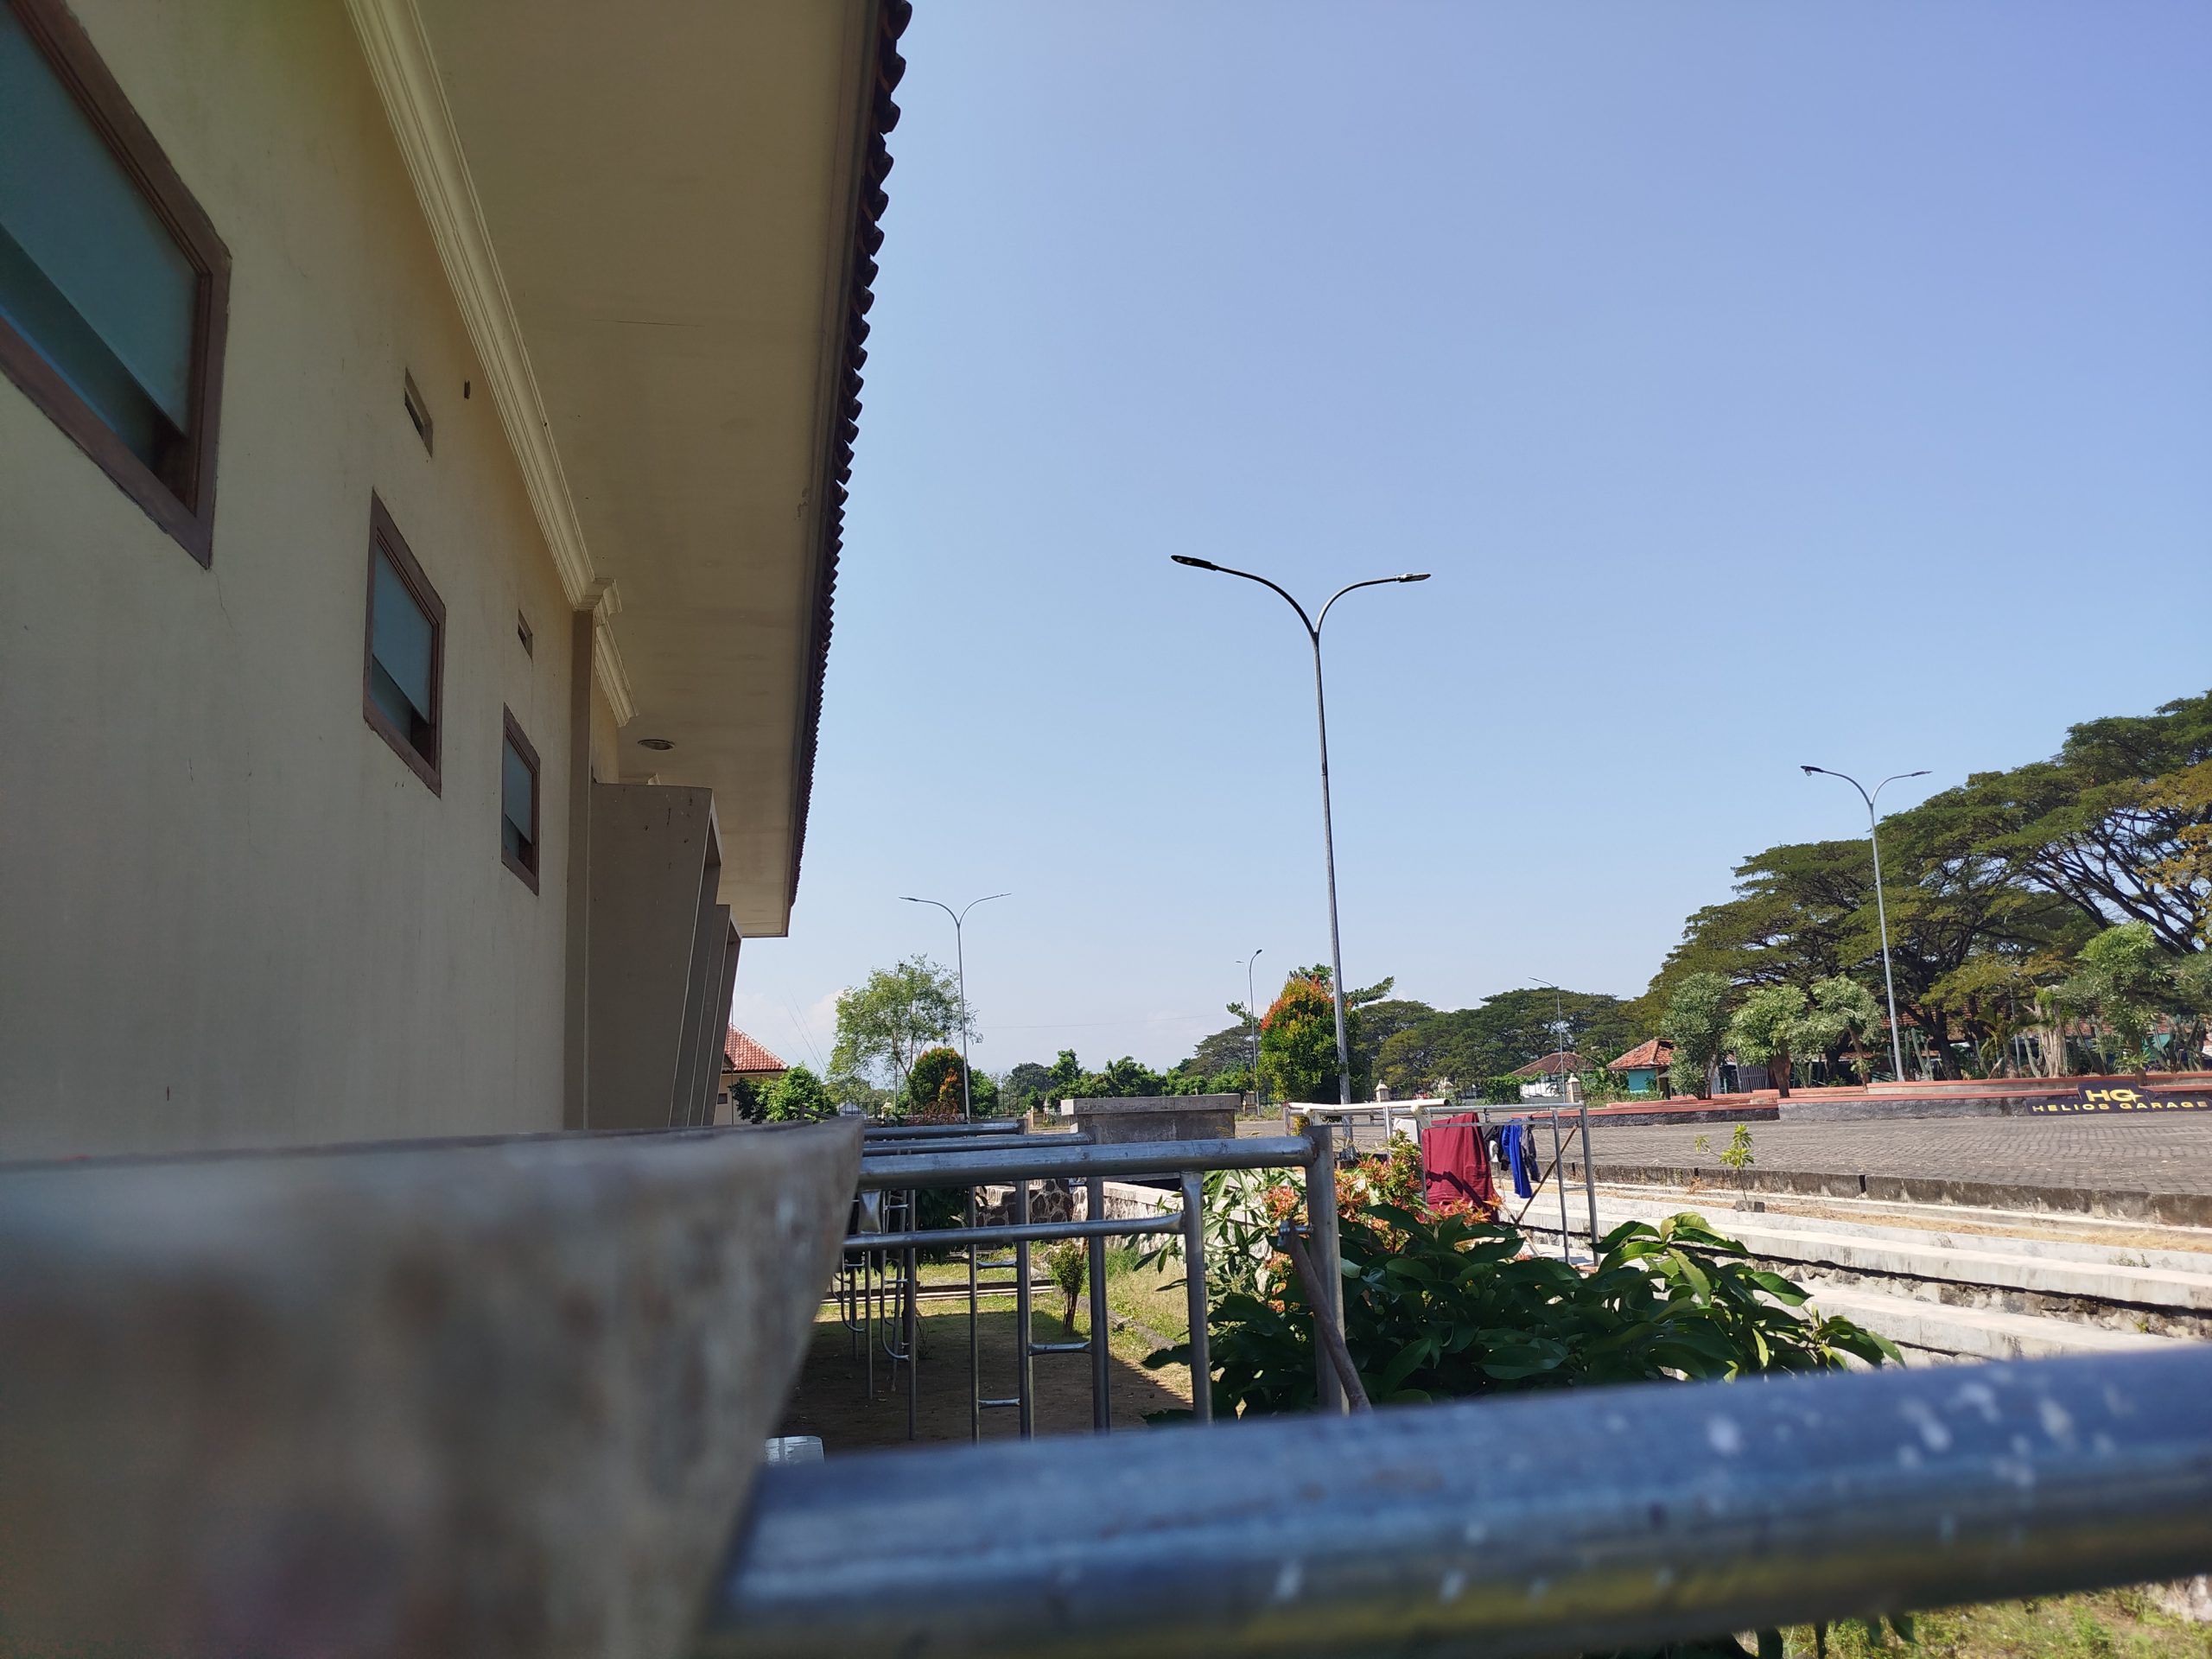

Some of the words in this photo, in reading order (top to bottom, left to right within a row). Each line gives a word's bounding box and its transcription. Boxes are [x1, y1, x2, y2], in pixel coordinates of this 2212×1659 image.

[2085, 1090, 2144, 1103] HG
[2032, 1103, 2110, 1112] HELIOS
[2120, 1101, 2209, 1109] GARAGE
